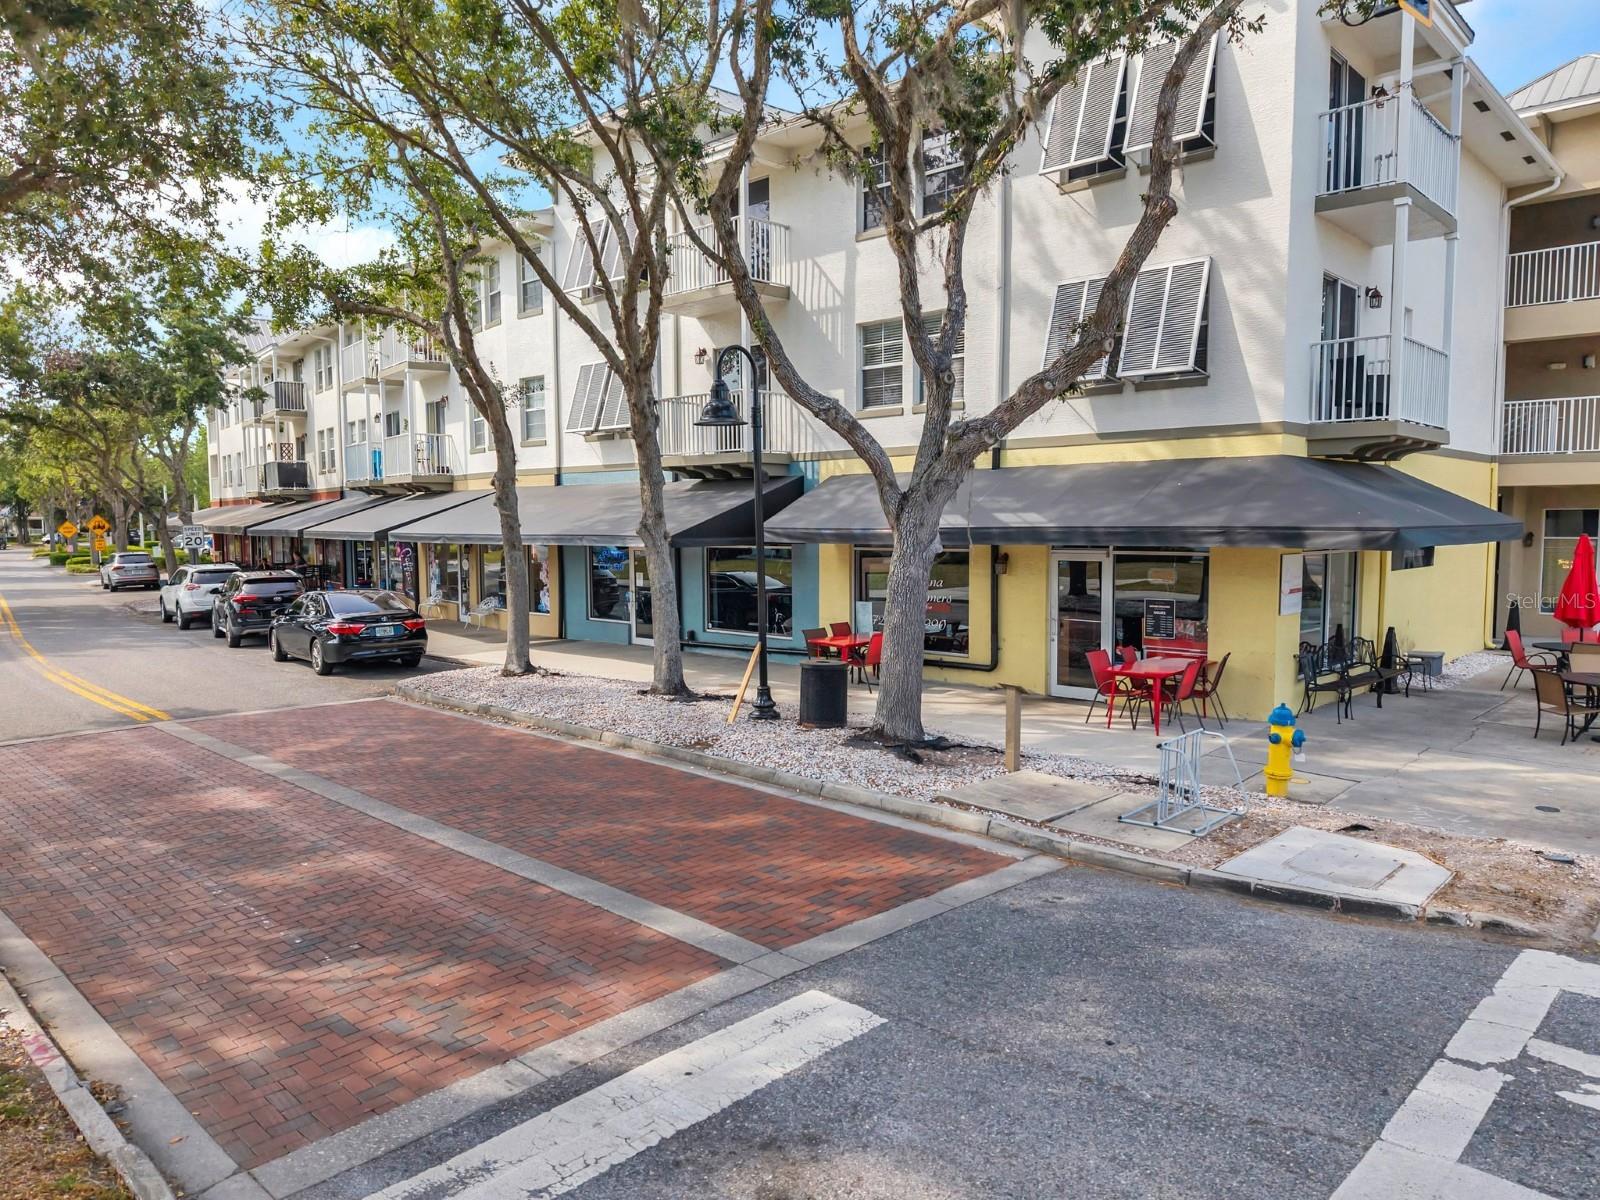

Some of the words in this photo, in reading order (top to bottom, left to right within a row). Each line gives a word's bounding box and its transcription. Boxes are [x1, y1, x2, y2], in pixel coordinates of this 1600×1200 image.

[185, 537, 202, 546] 20
[928, 579, 944, 587] na
[926, 594, 952, 603] mers
